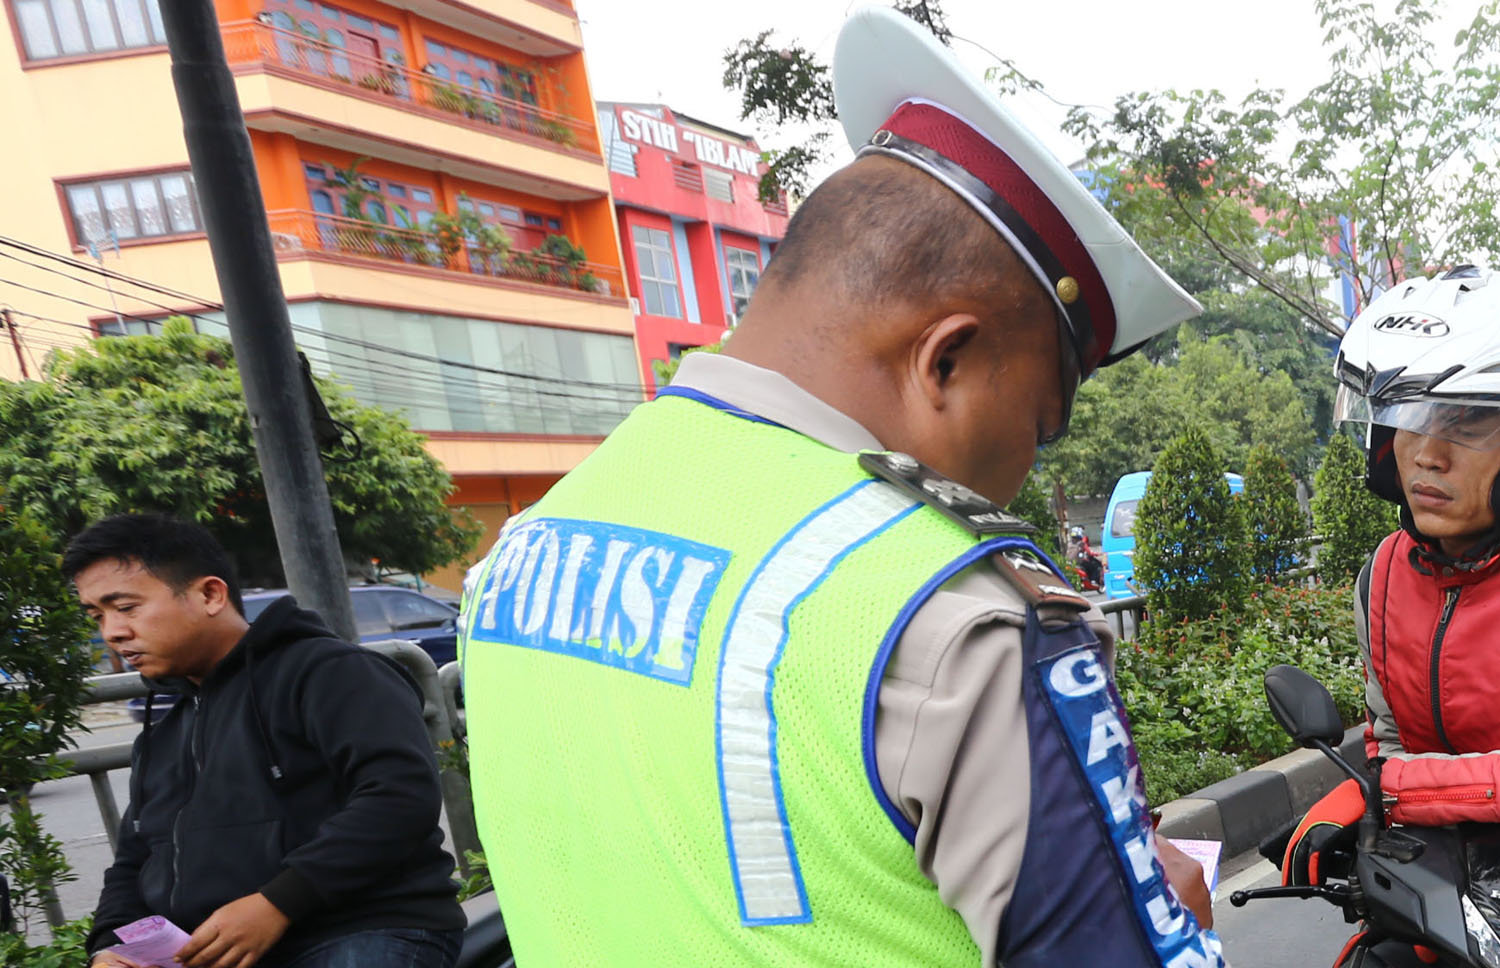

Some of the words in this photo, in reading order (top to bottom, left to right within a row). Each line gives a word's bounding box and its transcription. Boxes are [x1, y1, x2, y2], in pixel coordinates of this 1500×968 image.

[621, 110, 679, 153] STIH
[1378, 316, 1444, 335] NHK
[481, 528, 714, 671] POLISI
